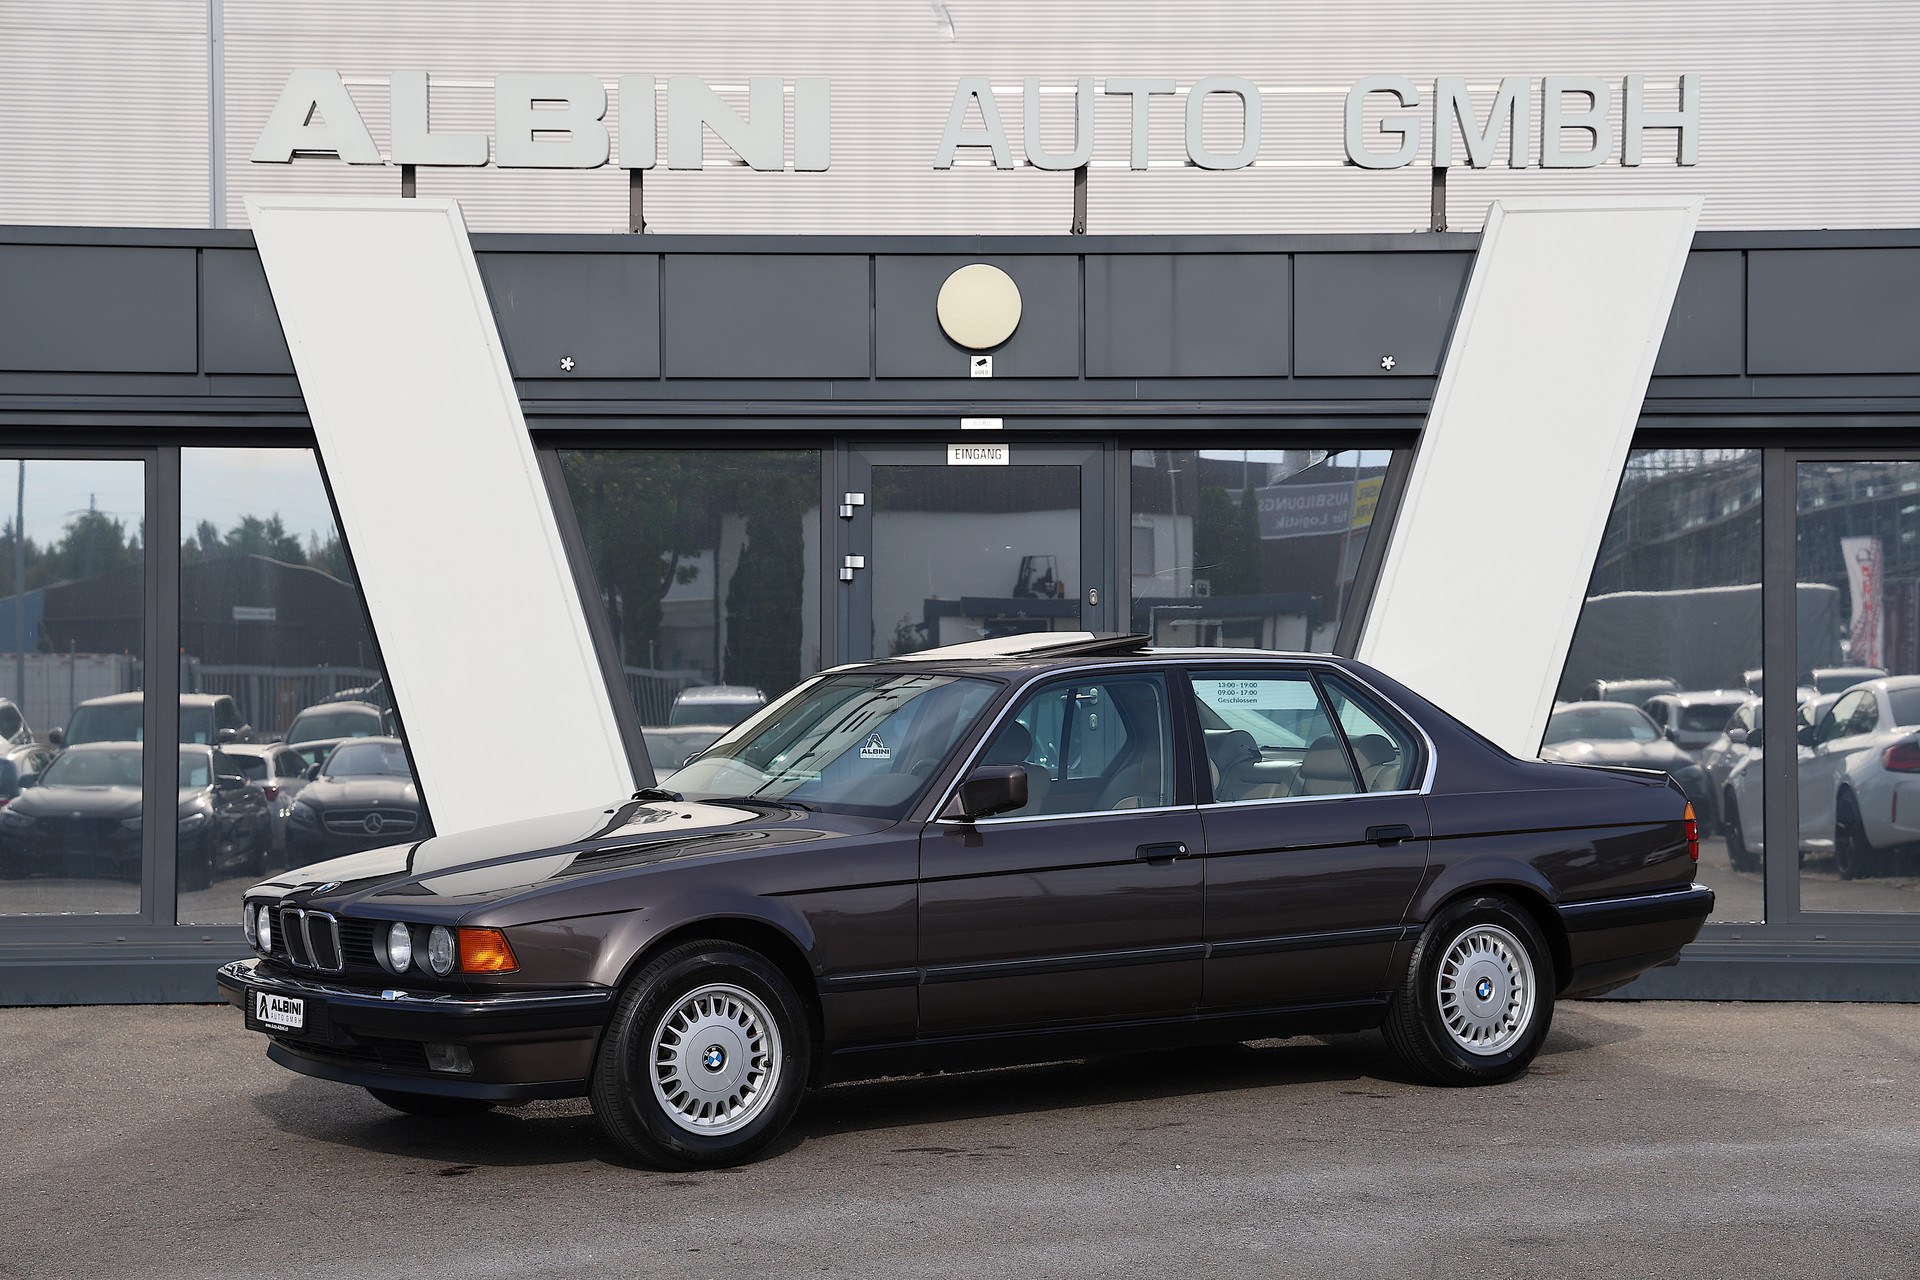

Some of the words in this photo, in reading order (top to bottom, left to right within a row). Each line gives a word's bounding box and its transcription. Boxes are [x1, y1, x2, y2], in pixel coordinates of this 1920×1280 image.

[250, 68, 831, 171] ALBINI
[933, 75, 1261, 170] AUTO
[1343, 74, 1701, 170] GMBH
[955, 448, 1002, 460] EINGANG
[271, 999, 301, 1015] ALBINI
